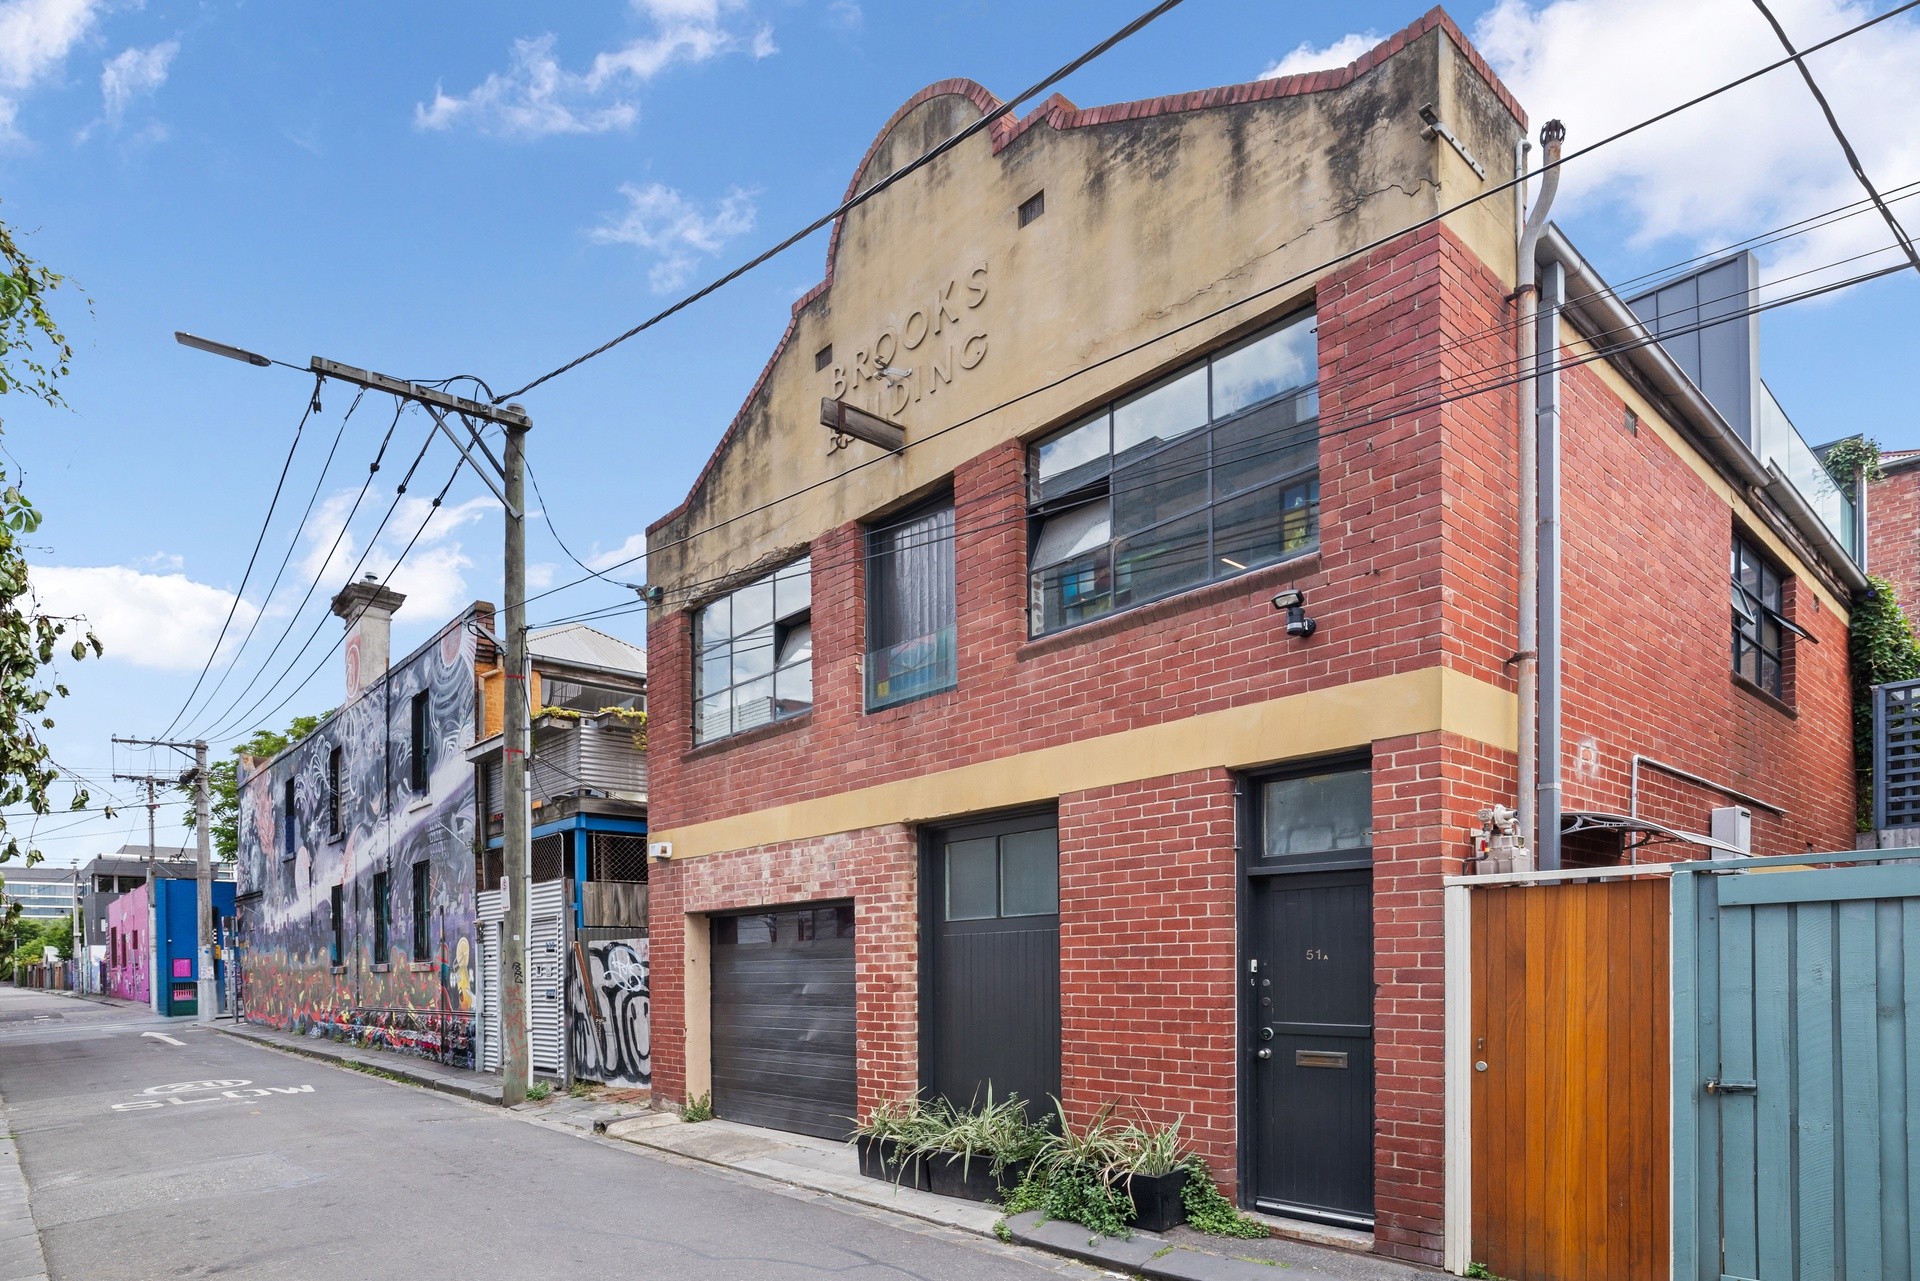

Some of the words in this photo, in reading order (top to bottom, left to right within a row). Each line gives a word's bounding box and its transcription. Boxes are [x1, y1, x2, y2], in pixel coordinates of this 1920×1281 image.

[826, 328, 989, 457] BLDING
[831, 262, 988, 401] BROOKS
[111, 1084, 315, 1111] SLOW
